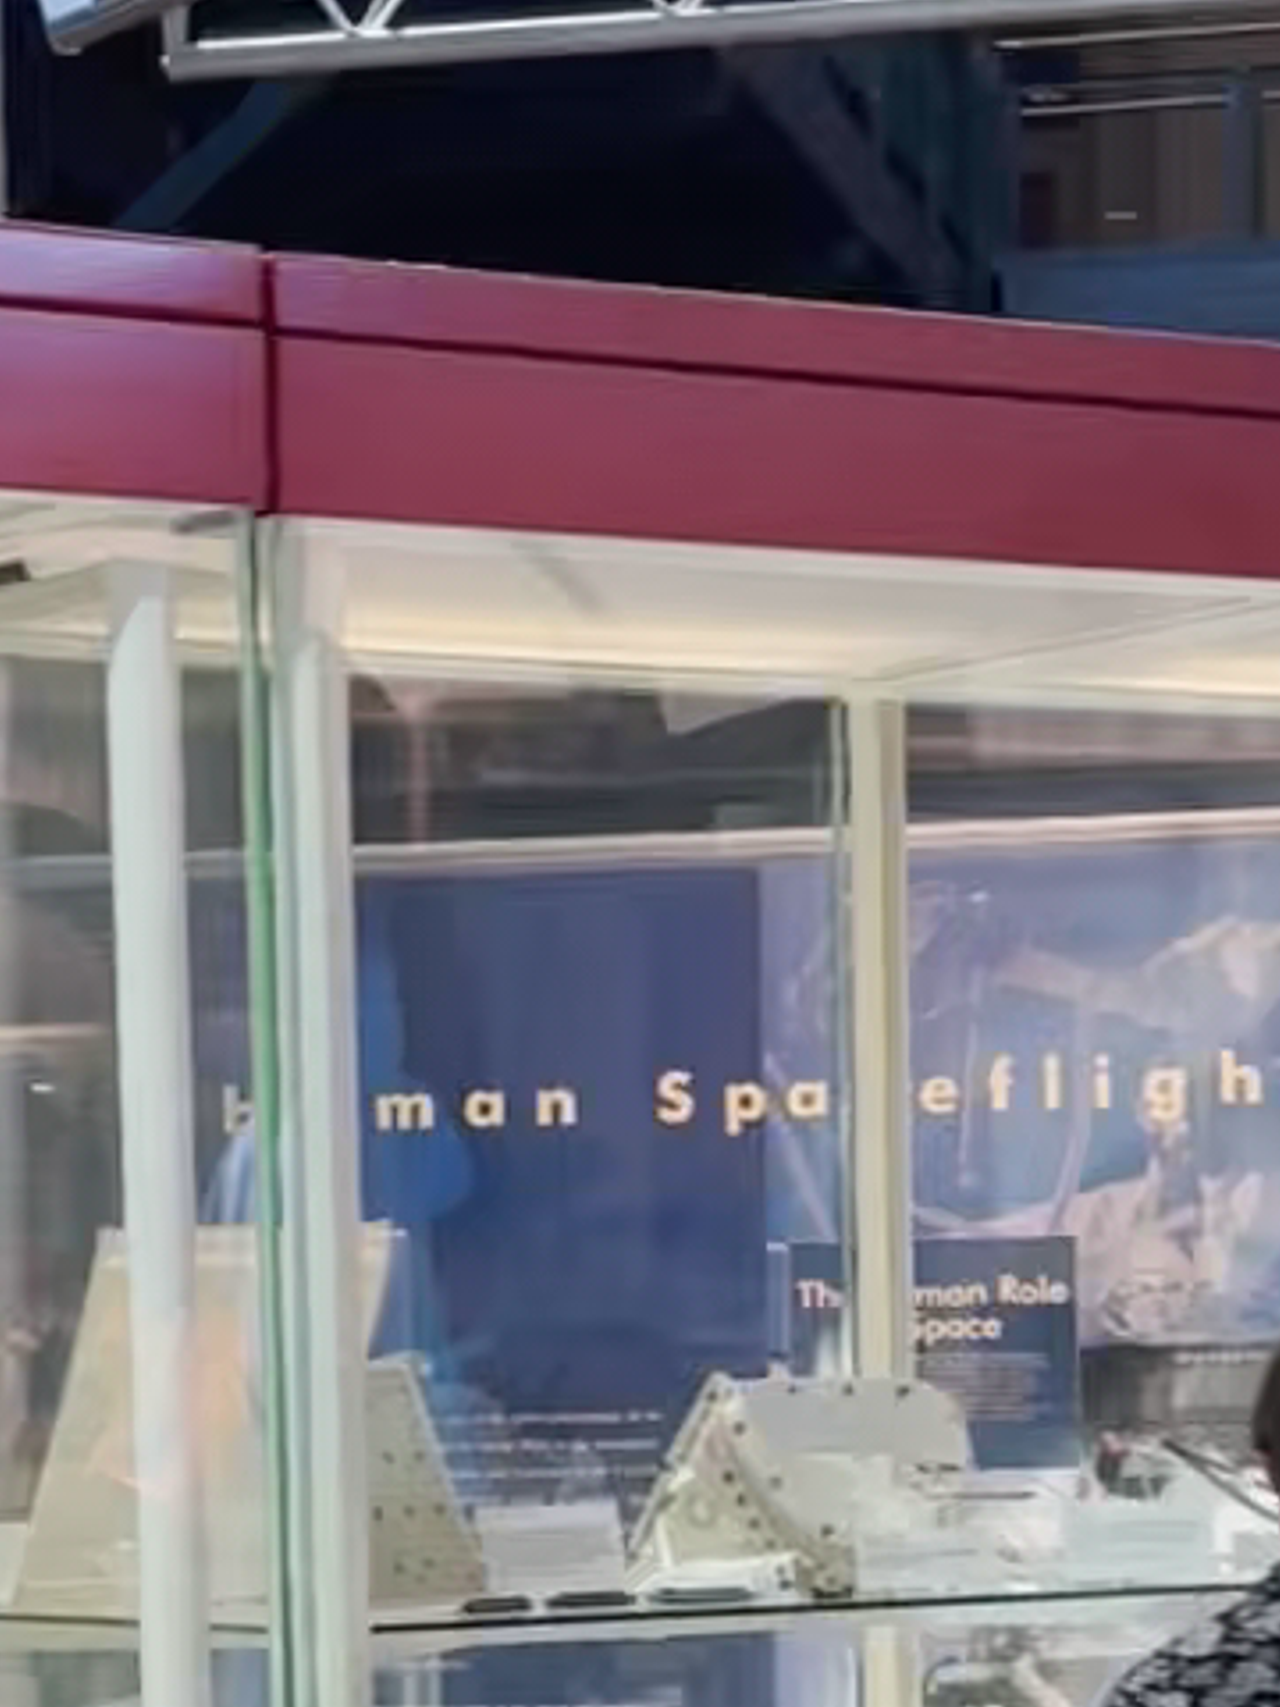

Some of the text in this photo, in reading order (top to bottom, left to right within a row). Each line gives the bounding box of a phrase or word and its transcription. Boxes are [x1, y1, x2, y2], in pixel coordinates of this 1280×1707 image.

[796, 1271, 1071, 1309] Th man Role
